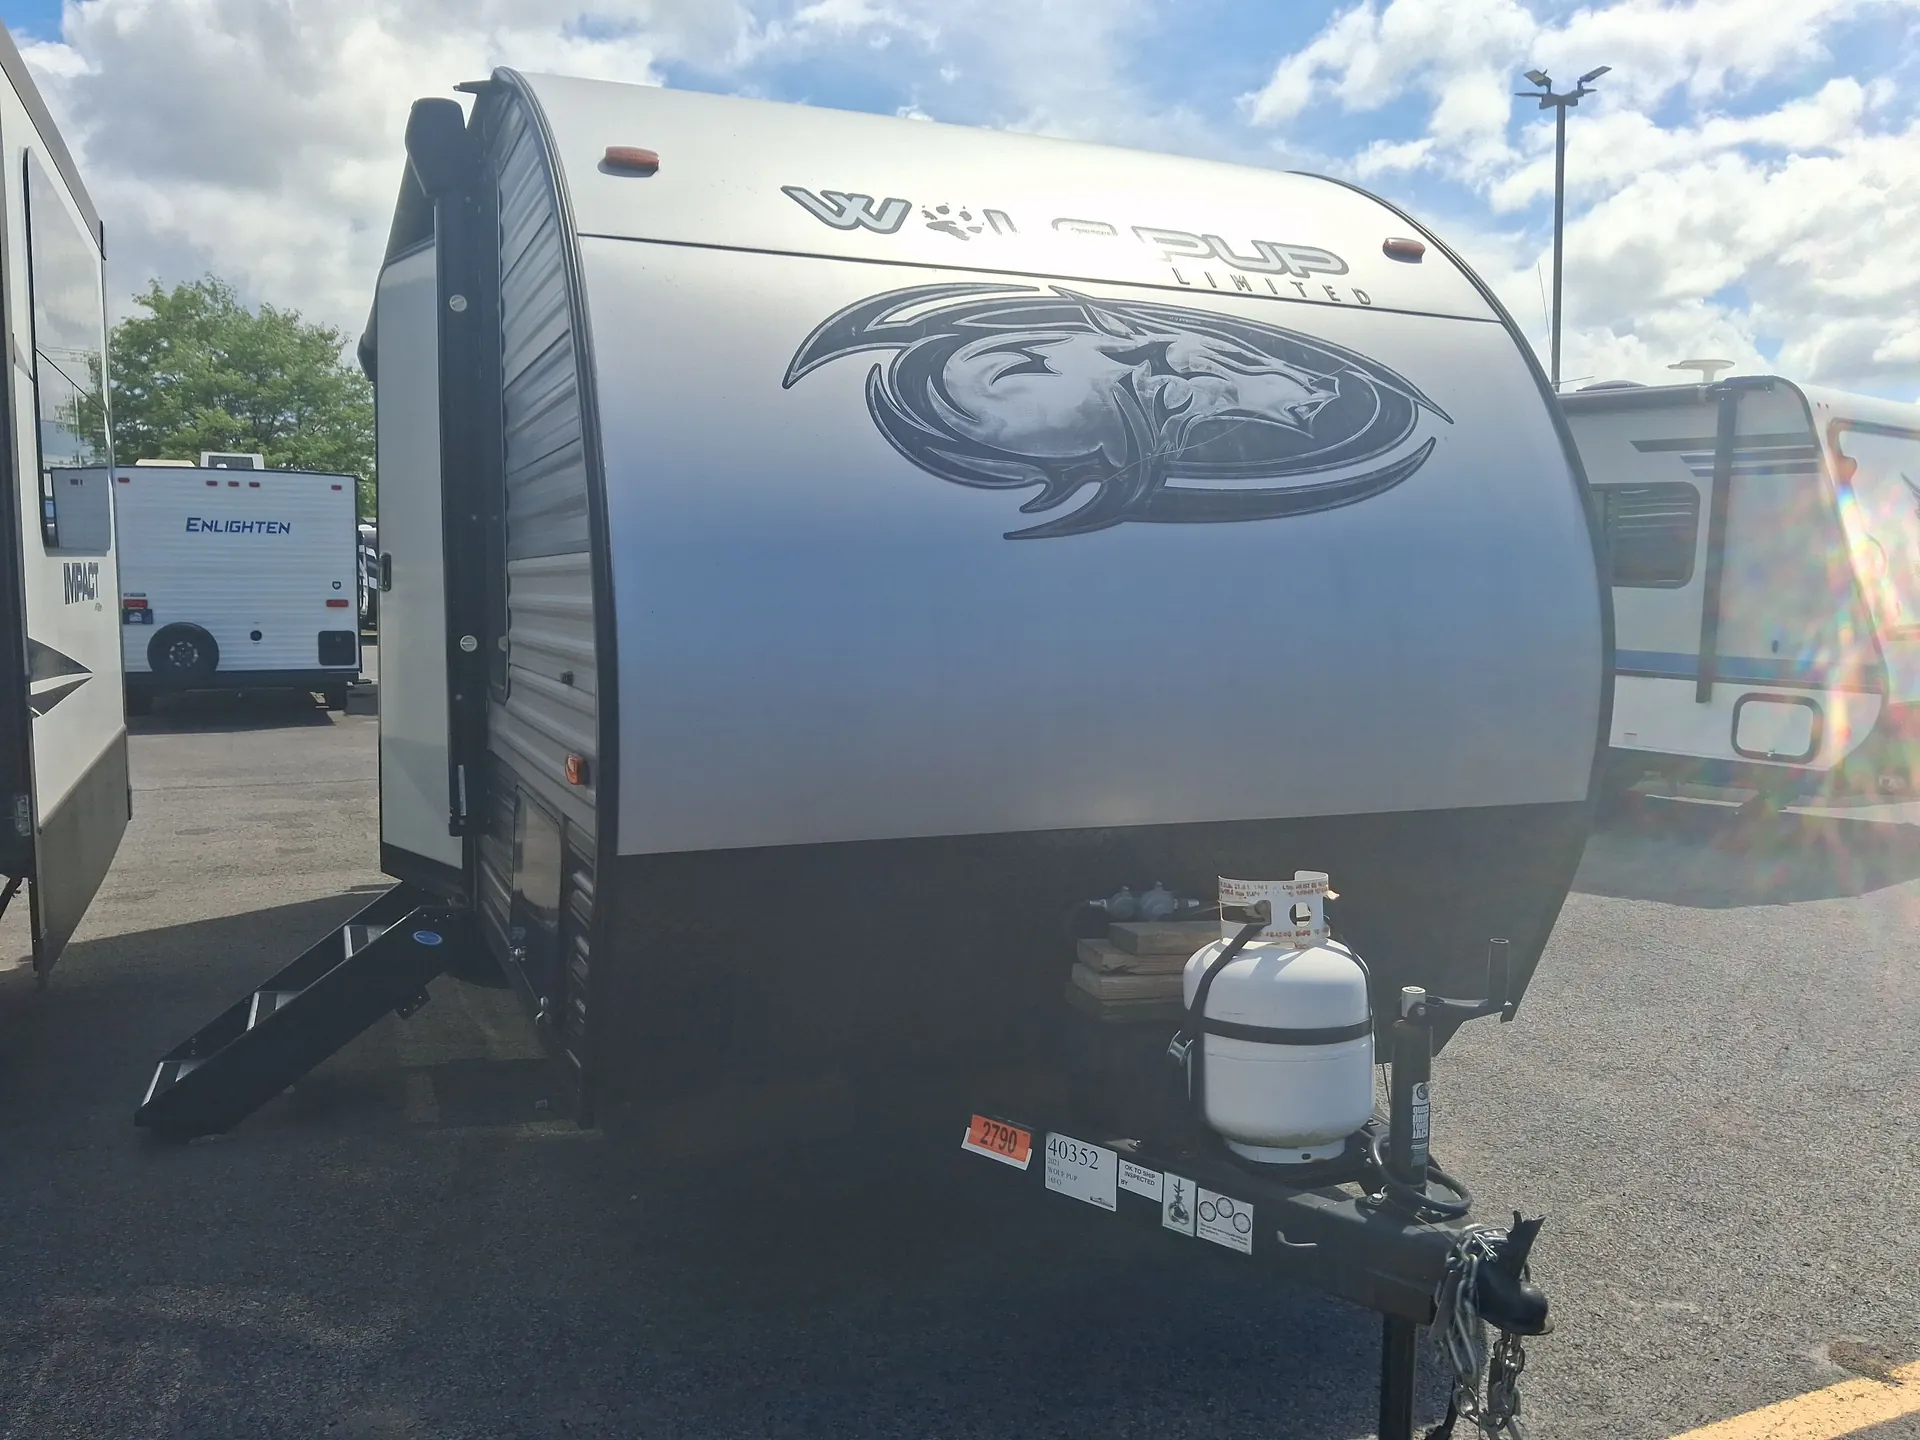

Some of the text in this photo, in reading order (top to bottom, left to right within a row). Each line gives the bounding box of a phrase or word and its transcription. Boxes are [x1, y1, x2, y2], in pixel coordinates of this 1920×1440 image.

[1171, 267, 1372, 306] LIMITED
[185, 517, 291, 535] ENLIGHTEN
[63, 562, 99, 605] IMPACT
[980, 1121, 1018, 1154] 2790
[1047, 1138, 1099, 1170] 40352
[1124, 1164, 1133, 1172] OK
[1142, 1170, 1156, 1179] SHIP
[1124, 1171, 1156, 1186] INSPECTED
